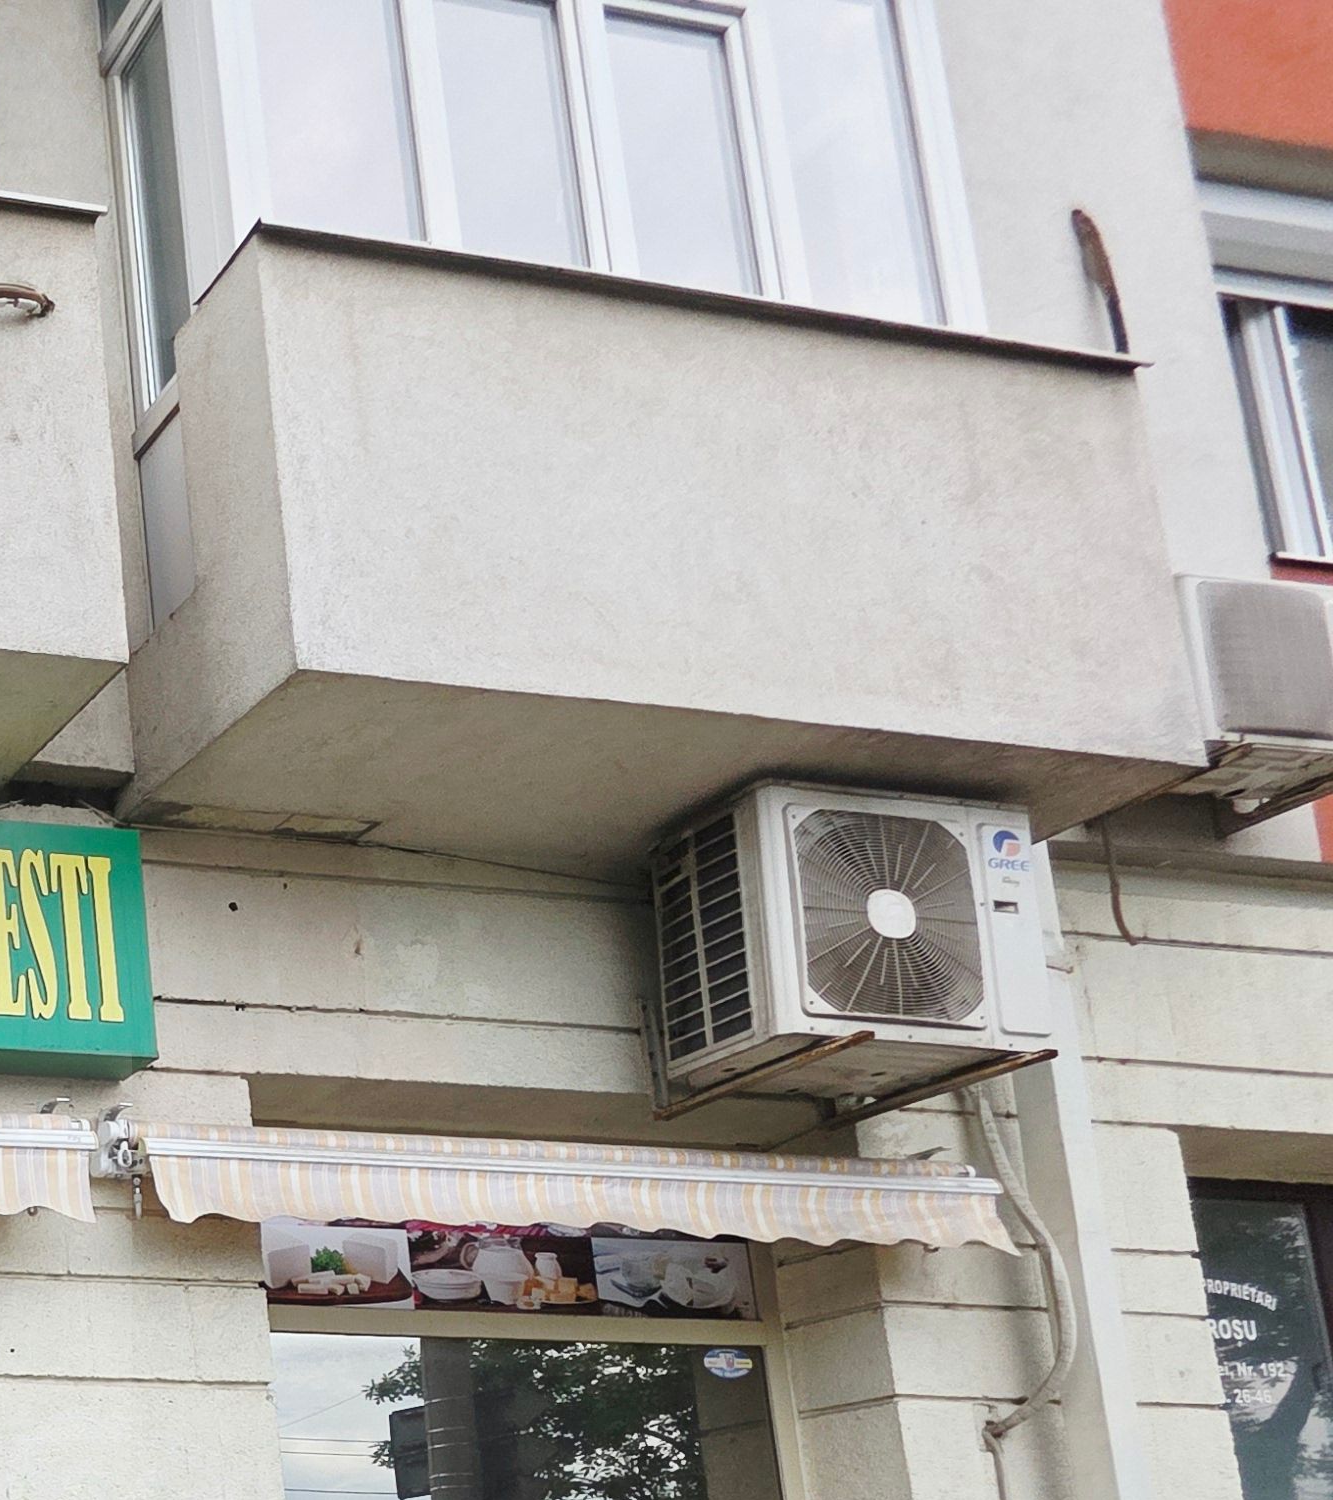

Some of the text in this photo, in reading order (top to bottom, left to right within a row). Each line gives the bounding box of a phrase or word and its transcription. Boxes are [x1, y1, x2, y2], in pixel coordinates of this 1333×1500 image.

[988, 857, 1030, 872] GREE
[1205, 1279, 1277, 1311] ROPRIETARI
[1260, 1362, 1286, 1377] 192
